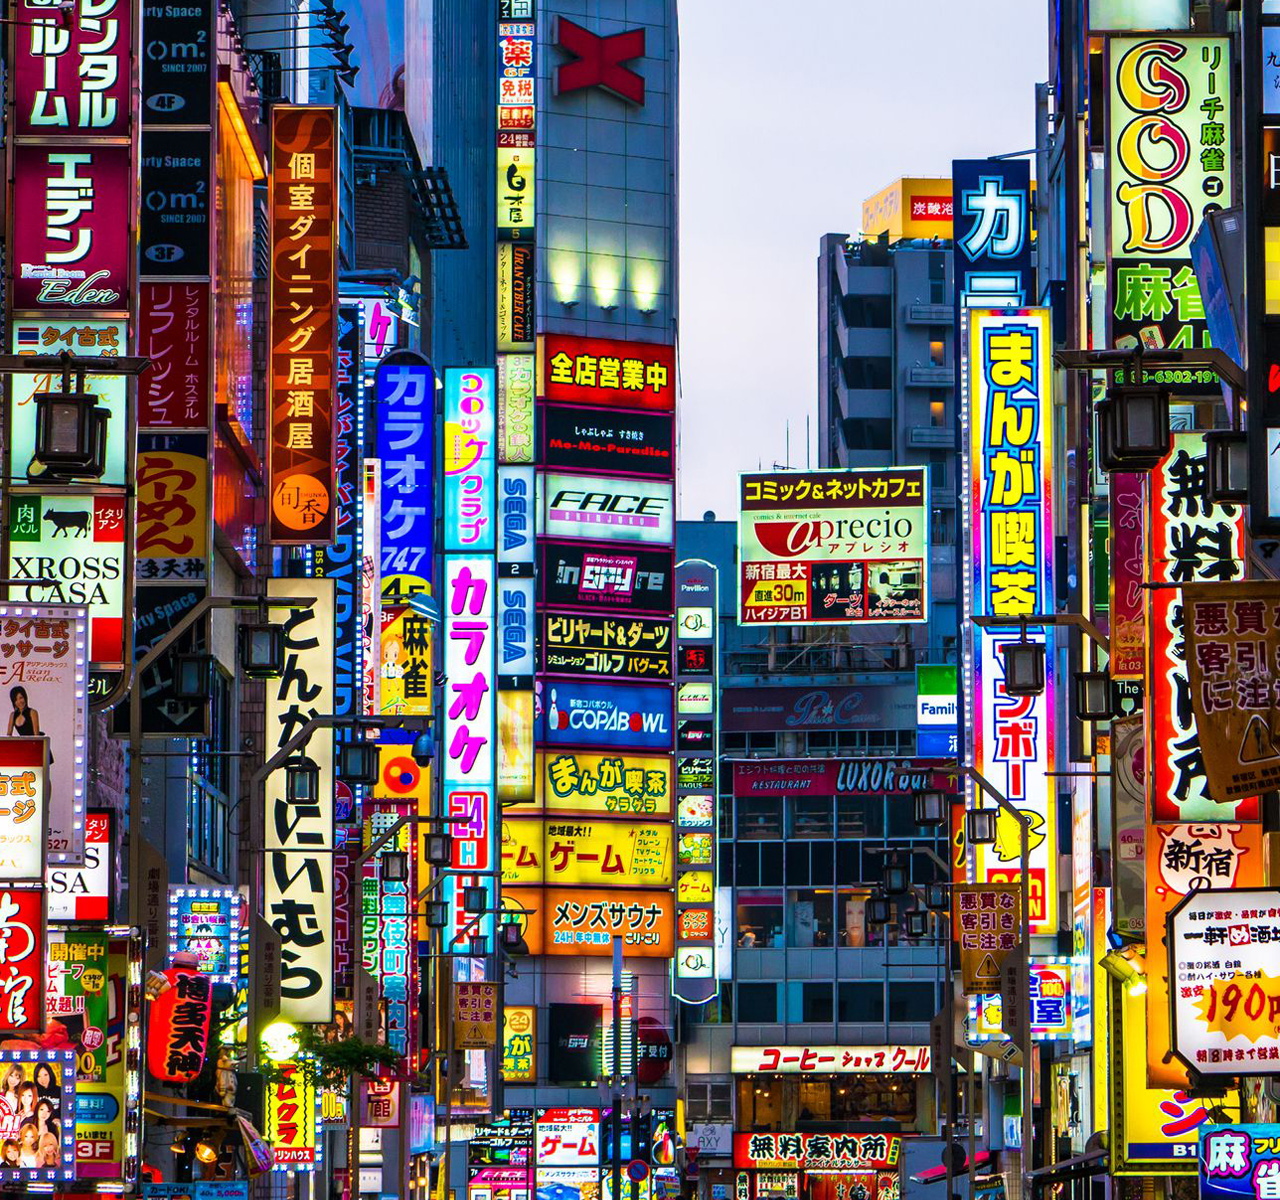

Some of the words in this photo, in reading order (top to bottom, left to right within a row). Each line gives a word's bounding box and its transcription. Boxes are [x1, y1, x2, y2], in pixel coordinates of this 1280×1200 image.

[166, 5, 202, 19] Space
[162, 64, 185, 73] SINCE
[186, 63, 208, 74] 2007
[501, 79, 533, 97] 免税
[1115, 39, 1194, 255] GOD
[165, 155, 201, 169] Space
[45, 152, 94, 264] エデン
[161, 213, 185, 224] SINCE
[154, 245, 176, 260] 3F
[35, 271, 121, 307] Eden
[286, 152, 316, 450] 個室ダイニング居酒屋
[186, 286, 199, 365] レンタルルーム
[148, 286, 175, 425] リフレッシュ
[550, 352, 669, 393] 全店営業中
[185, 374, 199, 419] ホステル
[575, 426, 613, 437] しゃぶしゃぶ
[619, 430, 644, 440] すき焼き
[382, 366, 426, 541] カラオケ
[549, 439, 669, 458] Mo-Mo-Paradise
[988, 326, 1039, 622] まんが喫茶
[745, 478, 921, 501] コミック&ネットカフェ
[503, 476, 527, 551] SEGA
[550, 490, 669, 516] FACE
[786, 510, 913, 553] aprecio
[380, 546, 427, 572] 747
[829, 542, 909, 553] アプレシオ
[11, 556, 120, 581] XROSS
[745, 563, 807, 580] 新宿最大
[25, 581, 110, 605] CASA
[754, 584, 805, 603] 直進30m
[823, 593, 863, 608] ダーツ
[745, 606, 808, 621] ハイジアB1
[3, 619, 70, 639] タイ古式
[503, 589, 526, 664] SEGA
[547, 617, 670, 650] ビリヤード&ダーツ
[402, 614, 429, 700] 麻雀
[628, 658, 669, 674] バグース
[448, 566, 489, 774] カラオケ
[549, 754, 668, 798] まんが喫茶
[752, 779, 811, 789] RESTAURANT
[550, 840, 625, 875] ゲーム
[1164, 838, 1234, 878] 新宿
[679, 883, 711, 894] ゲーム
[960, 892, 1015, 910] 悪質な
[553, 901, 664, 930] メンズサウナ
[961, 912, 1015, 931] 客引き
[553, 930, 575, 944] 24H
[575, 931, 610, 945] 年中無休
[962, 932, 1016, 950] に注意
[50, 943, 105, 963] 開催中
[1180, 985, 1205, 999] 激安
[757, 1048, 836, 1071] コーヒー
[842, 1051, 885, 1067] ショップ
[891, 1046, 931, 1072] クール
[77, 1141, 111, 1158] 3F
[540, 1136, 598, 1156] ゲーム
[748, 1134, 887, 1161] 無料案内所
